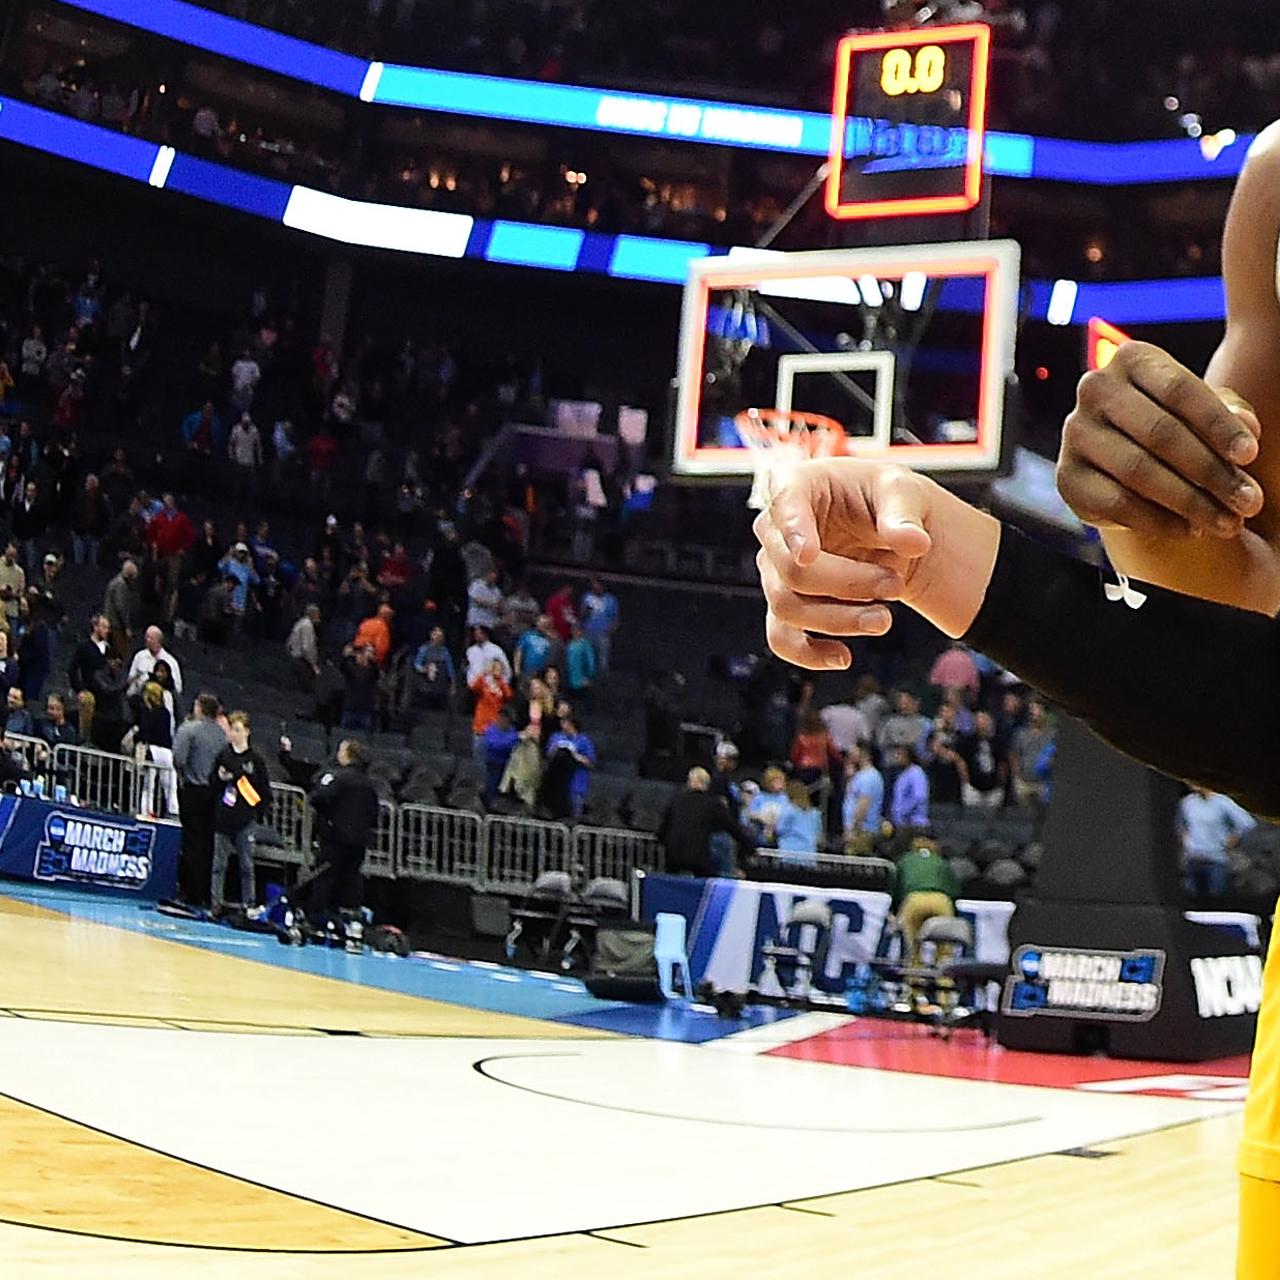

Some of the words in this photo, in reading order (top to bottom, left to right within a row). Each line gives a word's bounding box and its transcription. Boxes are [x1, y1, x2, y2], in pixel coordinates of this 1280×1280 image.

[880, 45, 946, 96] 0.0
[64, 820, 126, 853] MARCH
[70, 847, 151, 880] MADNESS
